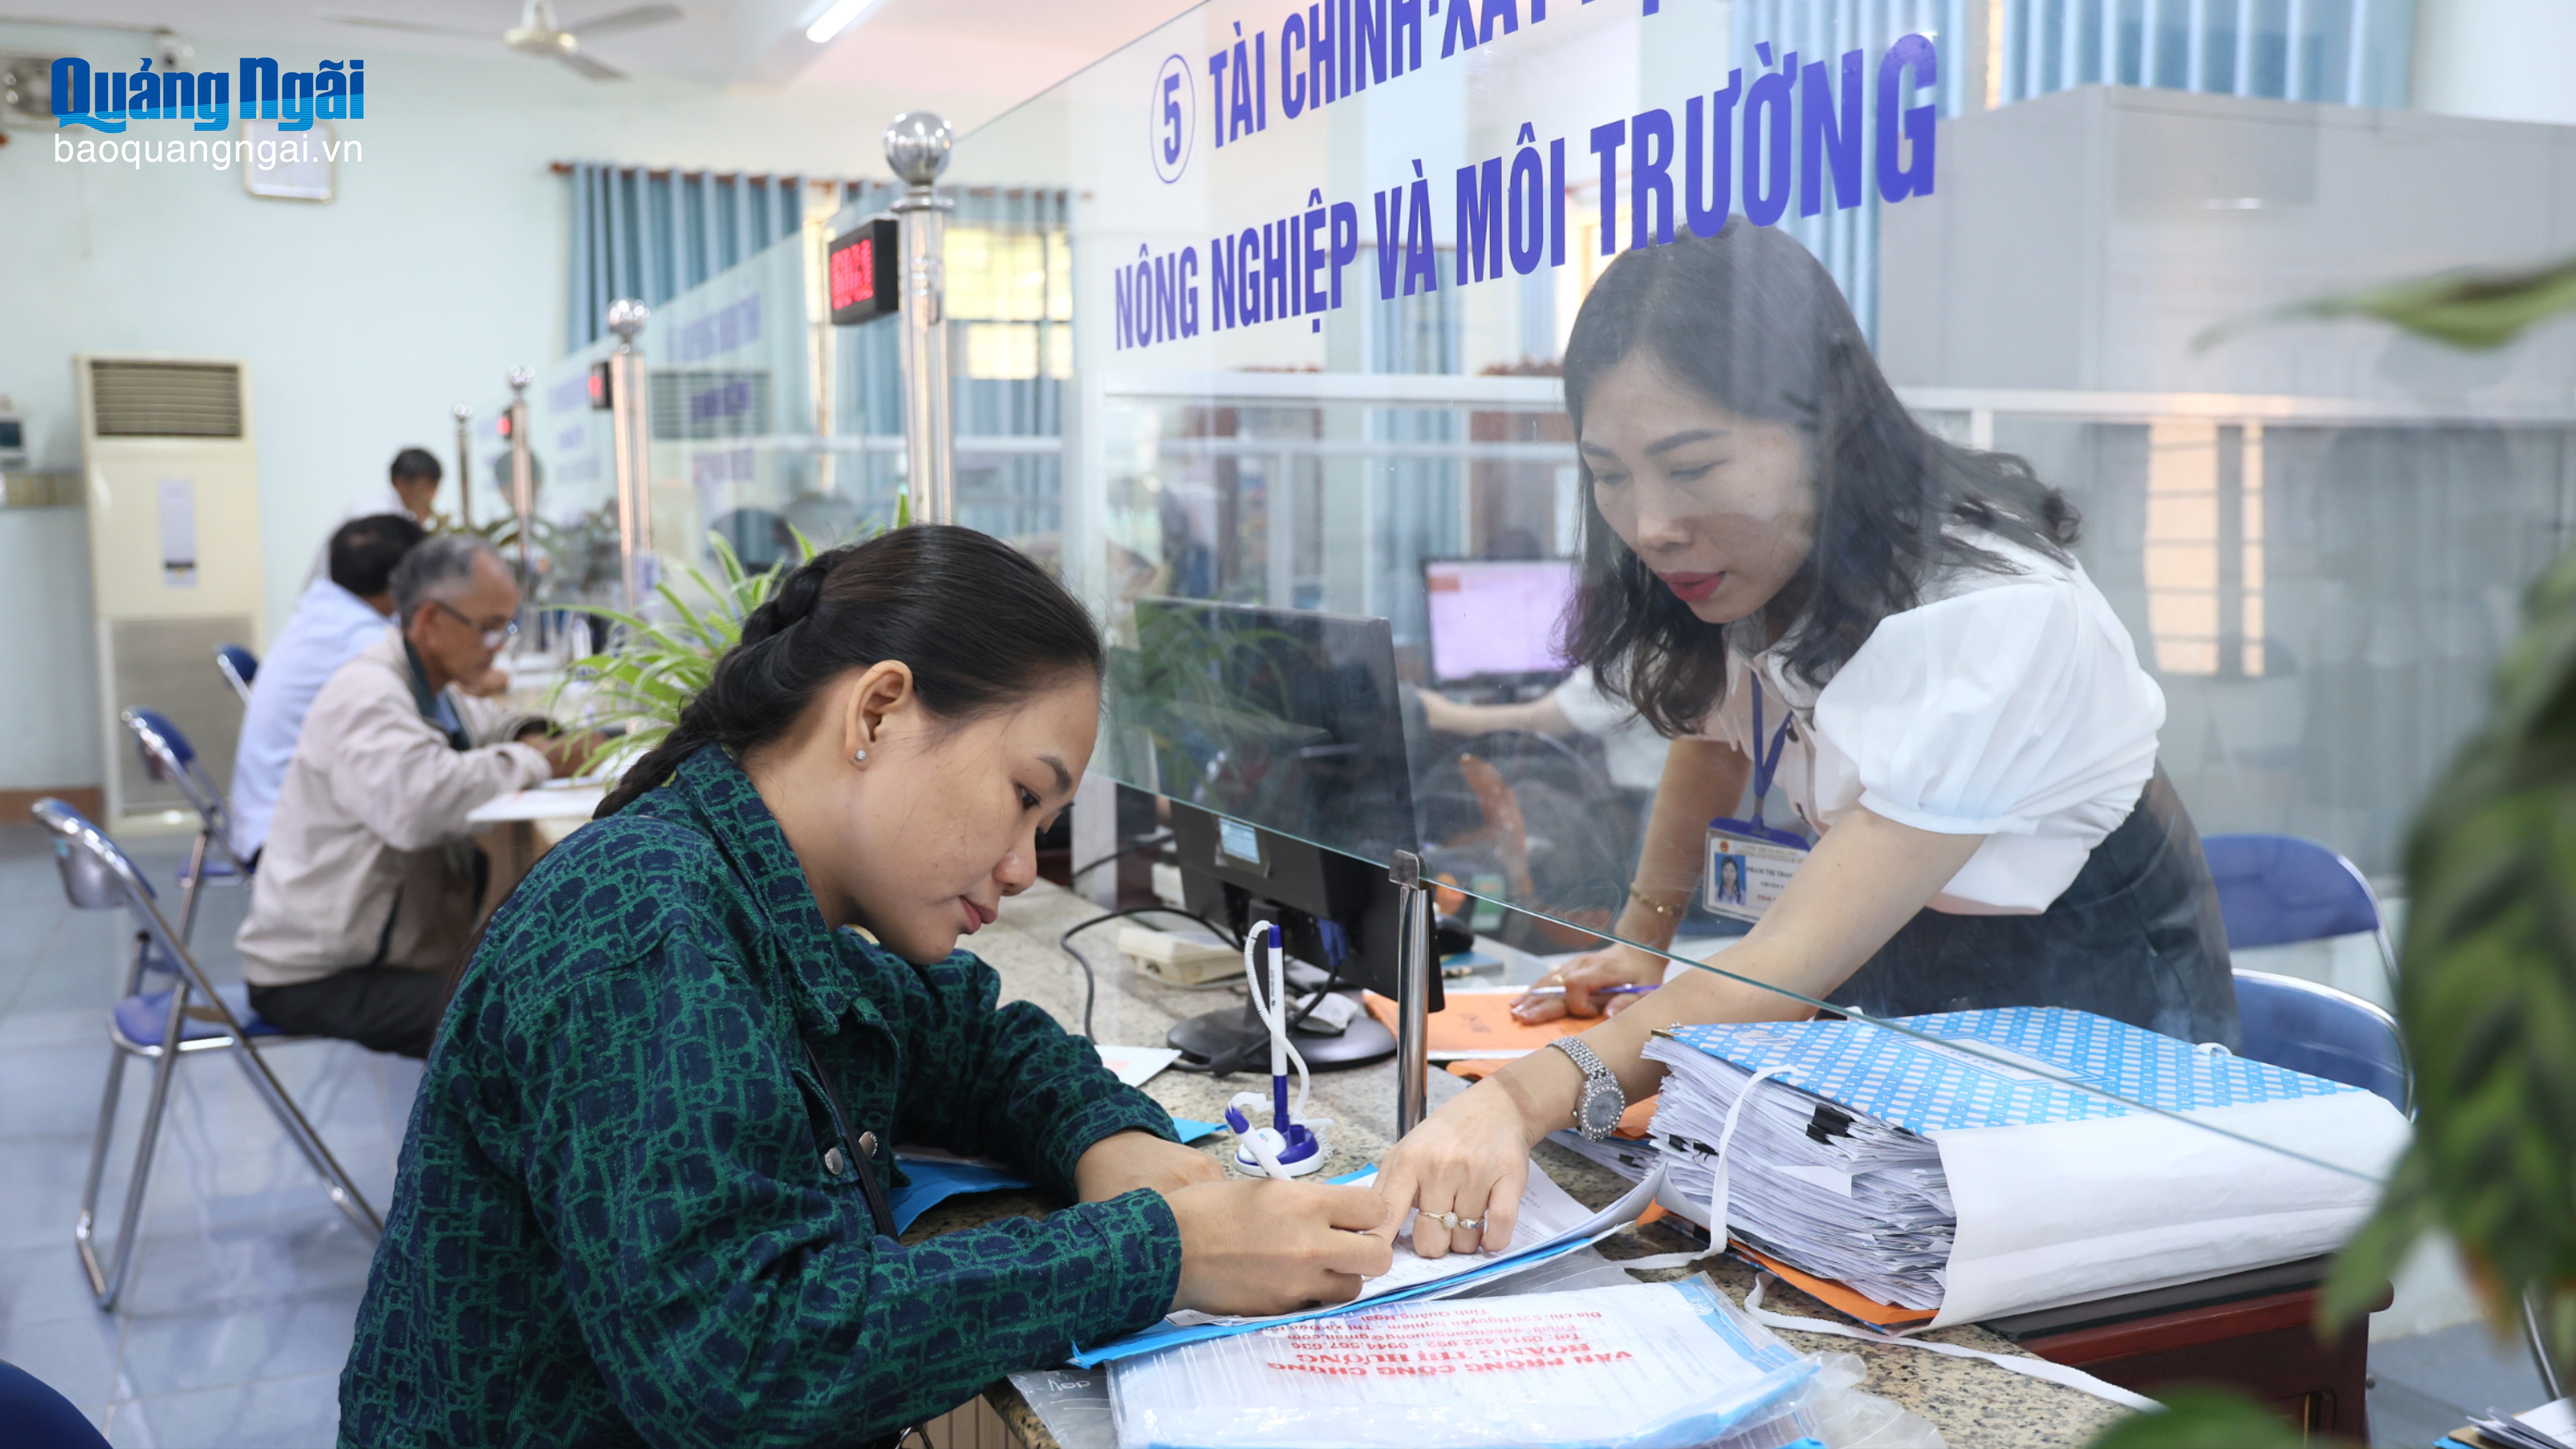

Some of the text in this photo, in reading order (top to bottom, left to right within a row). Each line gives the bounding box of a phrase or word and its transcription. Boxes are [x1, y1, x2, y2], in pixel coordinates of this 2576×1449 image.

[1163, 72, 1182, 166] 5
[1209, 21, 1267, 149] TÀI
[1115, 33, 1938, 351] NÔNG NGHIỆP VÀ MÔI TRƯỜNG
[1451, 1316, 1510, 1327] Nguyễn
[1576, 1311, 1602, 1319] Địa
[1527, 1324, 1577, 1333] Email:
[1427, 1335, 1543, 1347] 0914.422.992
[1295, 1343, 1592, 1365] HOÀNG THỊ HƯƠNG
[1267, 1351, 1633, 1378] VĂN PHÒNG CÔNG CHỨNG
